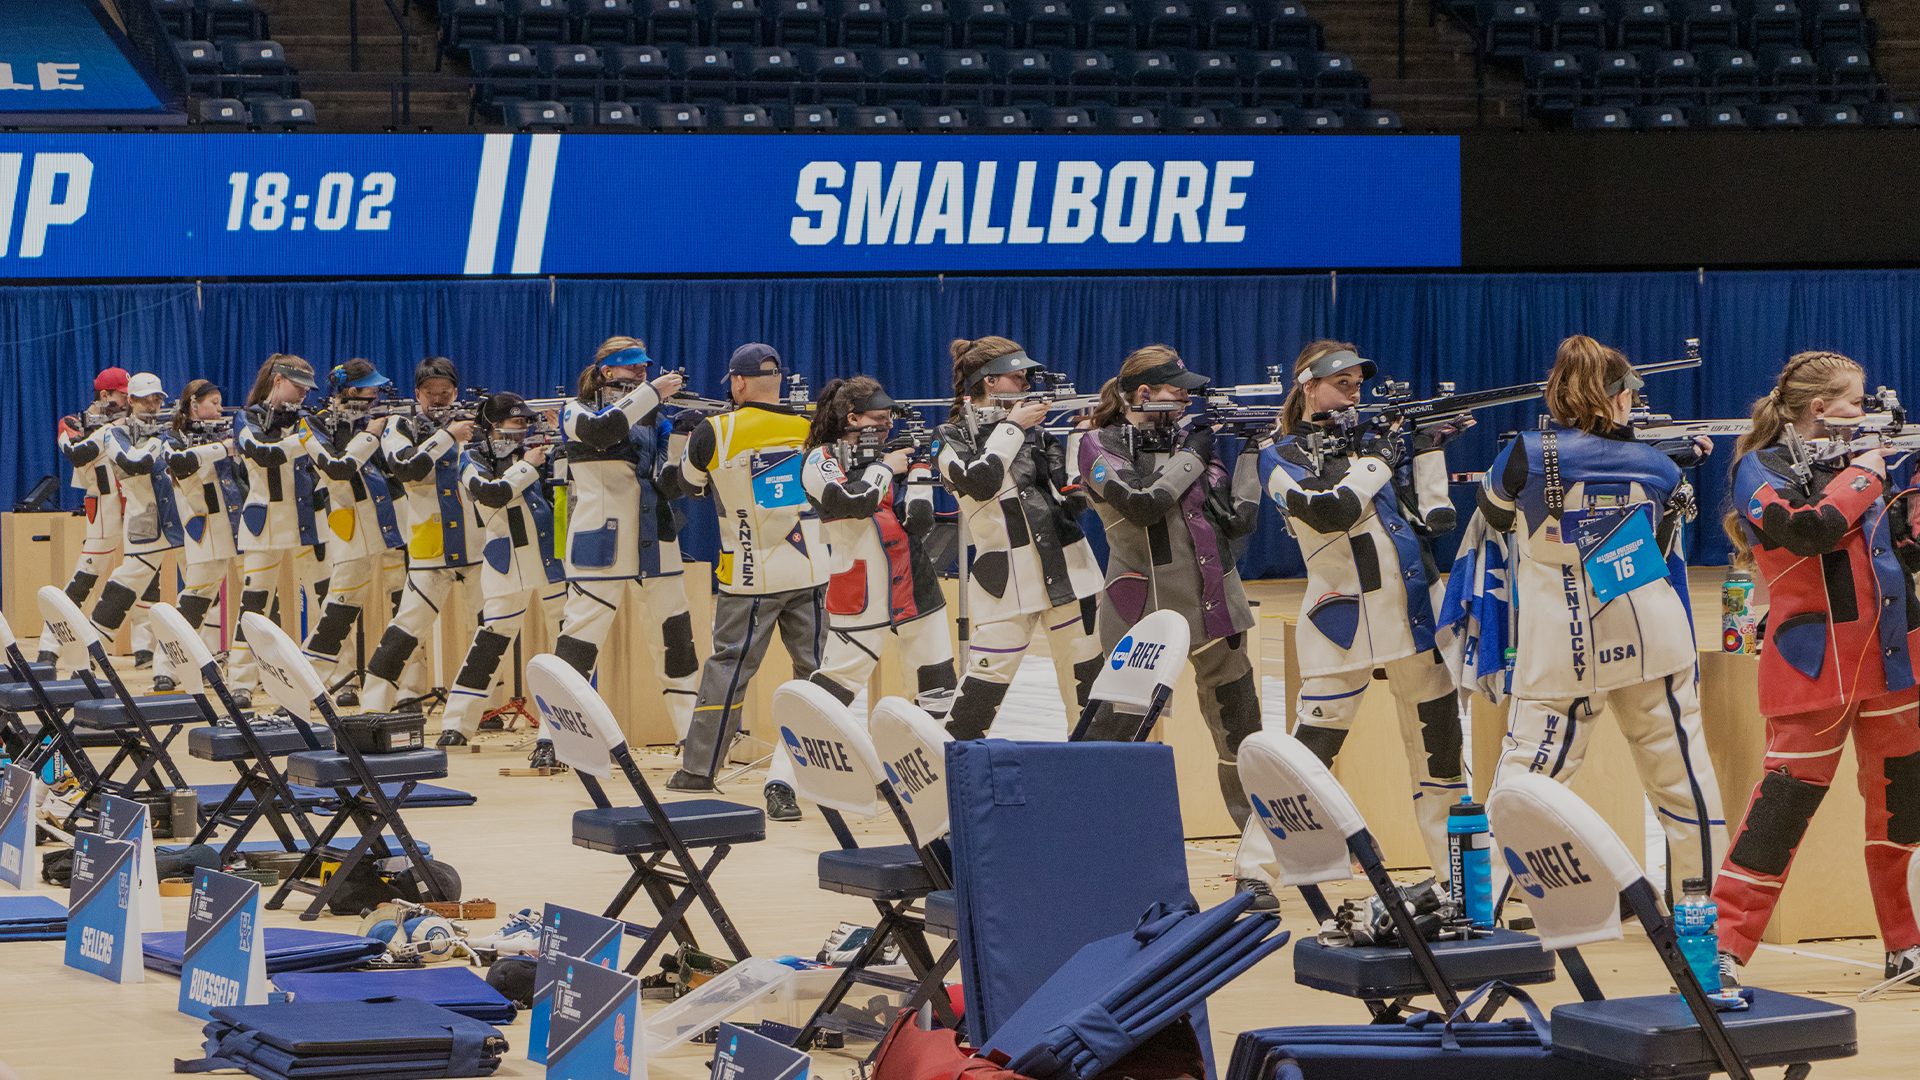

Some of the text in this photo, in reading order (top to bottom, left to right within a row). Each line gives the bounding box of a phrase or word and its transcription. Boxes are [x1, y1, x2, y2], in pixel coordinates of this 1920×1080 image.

[226, 172, 397, 231] 18:02
[789, 161, 1255, 246] SMALLBORE
[774, 483, 784, 499] 3
[736, 508, 754, 587] SANCHEZ
[1613, 556, 1635, 581] 16
[1562, 564, 1586, 681] KENTUCKY
[1127, 641, 1166, 670] RIFLE
[1600, 644, 1636, 664] USA
[551, 705, 593, 738] RIFLE
[801, 736, 853, 772] RIFLE
[894, 747, 939, 795] RIFLE
[1268, 793, 1323, 832] RIFLE
[1450, 836, 1464, 905] OWERADE
[1525, 842, 1592, 889] RIFLE
[1685, 906, 1717, 918] POWER
[1685, 916, 1706, 925] ADE
[80, 925, 114, 965] SELLERS
